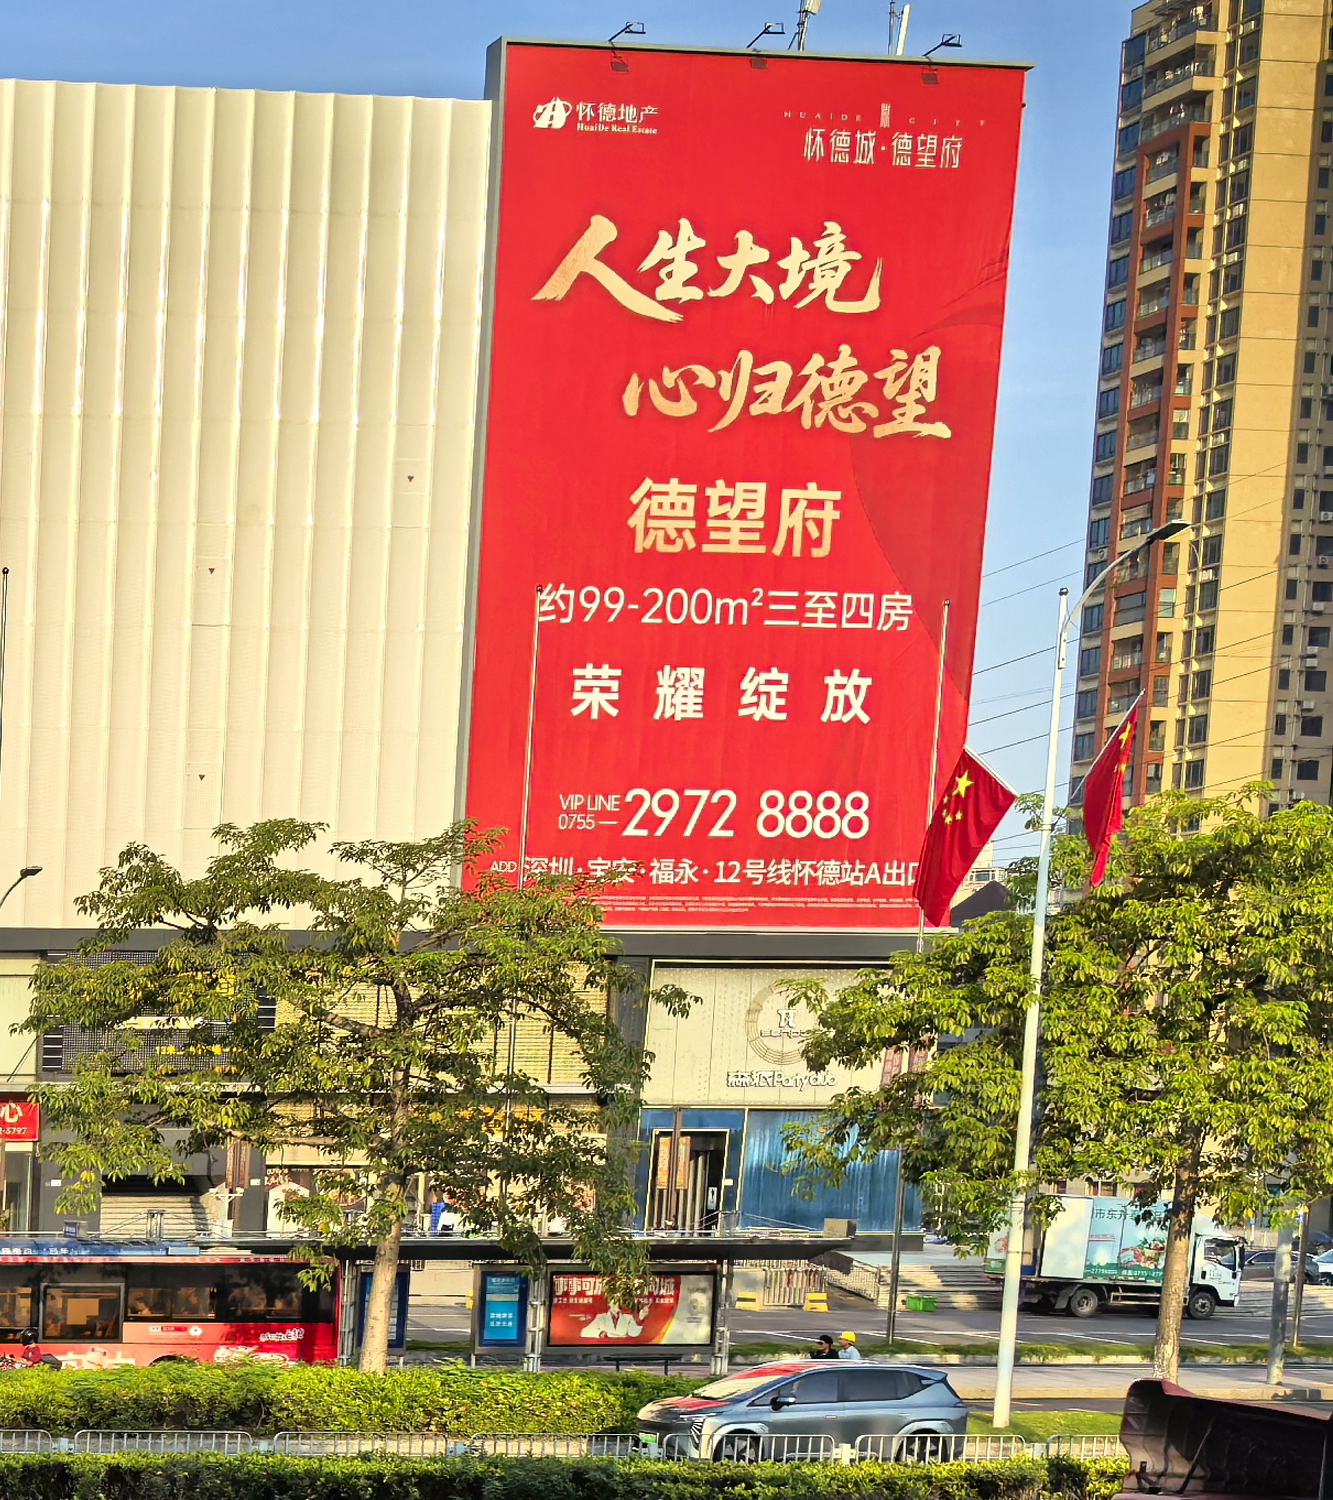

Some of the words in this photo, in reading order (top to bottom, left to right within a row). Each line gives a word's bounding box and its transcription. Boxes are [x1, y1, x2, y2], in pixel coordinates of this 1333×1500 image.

[576, 102, 658, 123] 怀德地产
[532, 214, 882, 324] 人生大境
[622, 345, 952, 439] 心归德望
[627, 477, 842, 558] 德望府
[559, 793, 584, 811] VIP
[588, 794, 621, 812] LINE
[621, 788, 738, 837] 2972
[756, 790, 870, 839] 8888
[490, 861, 517, 873] ADD
